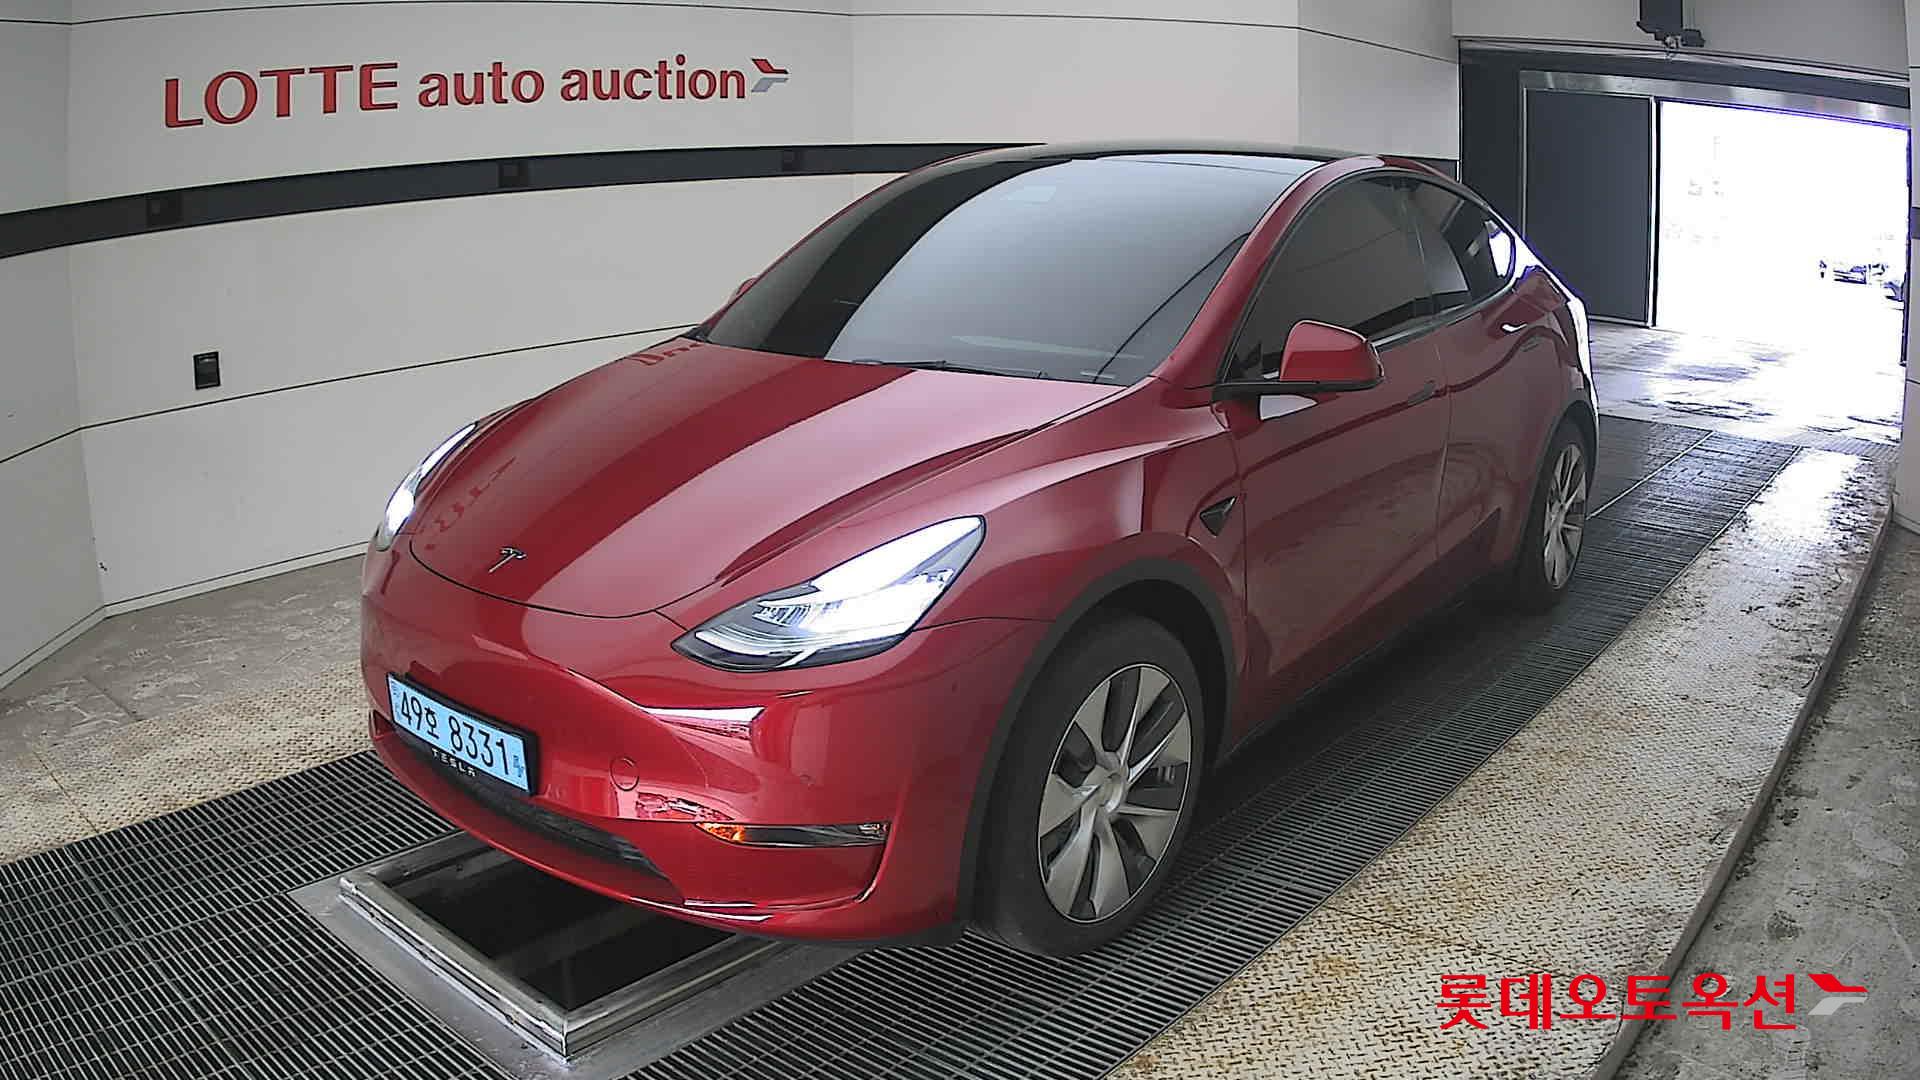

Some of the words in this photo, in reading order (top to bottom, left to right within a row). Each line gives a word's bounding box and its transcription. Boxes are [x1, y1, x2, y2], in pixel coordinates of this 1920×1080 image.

[164, 62, 400, 128] LOTTE
[418, 61, 545, 108] auto
[559, 54, 746, 102] auction
[401, 691, 440, 739] 49호
[448, 715, 510, 775] 8331
[431, 747, 477, 777] TESLA
